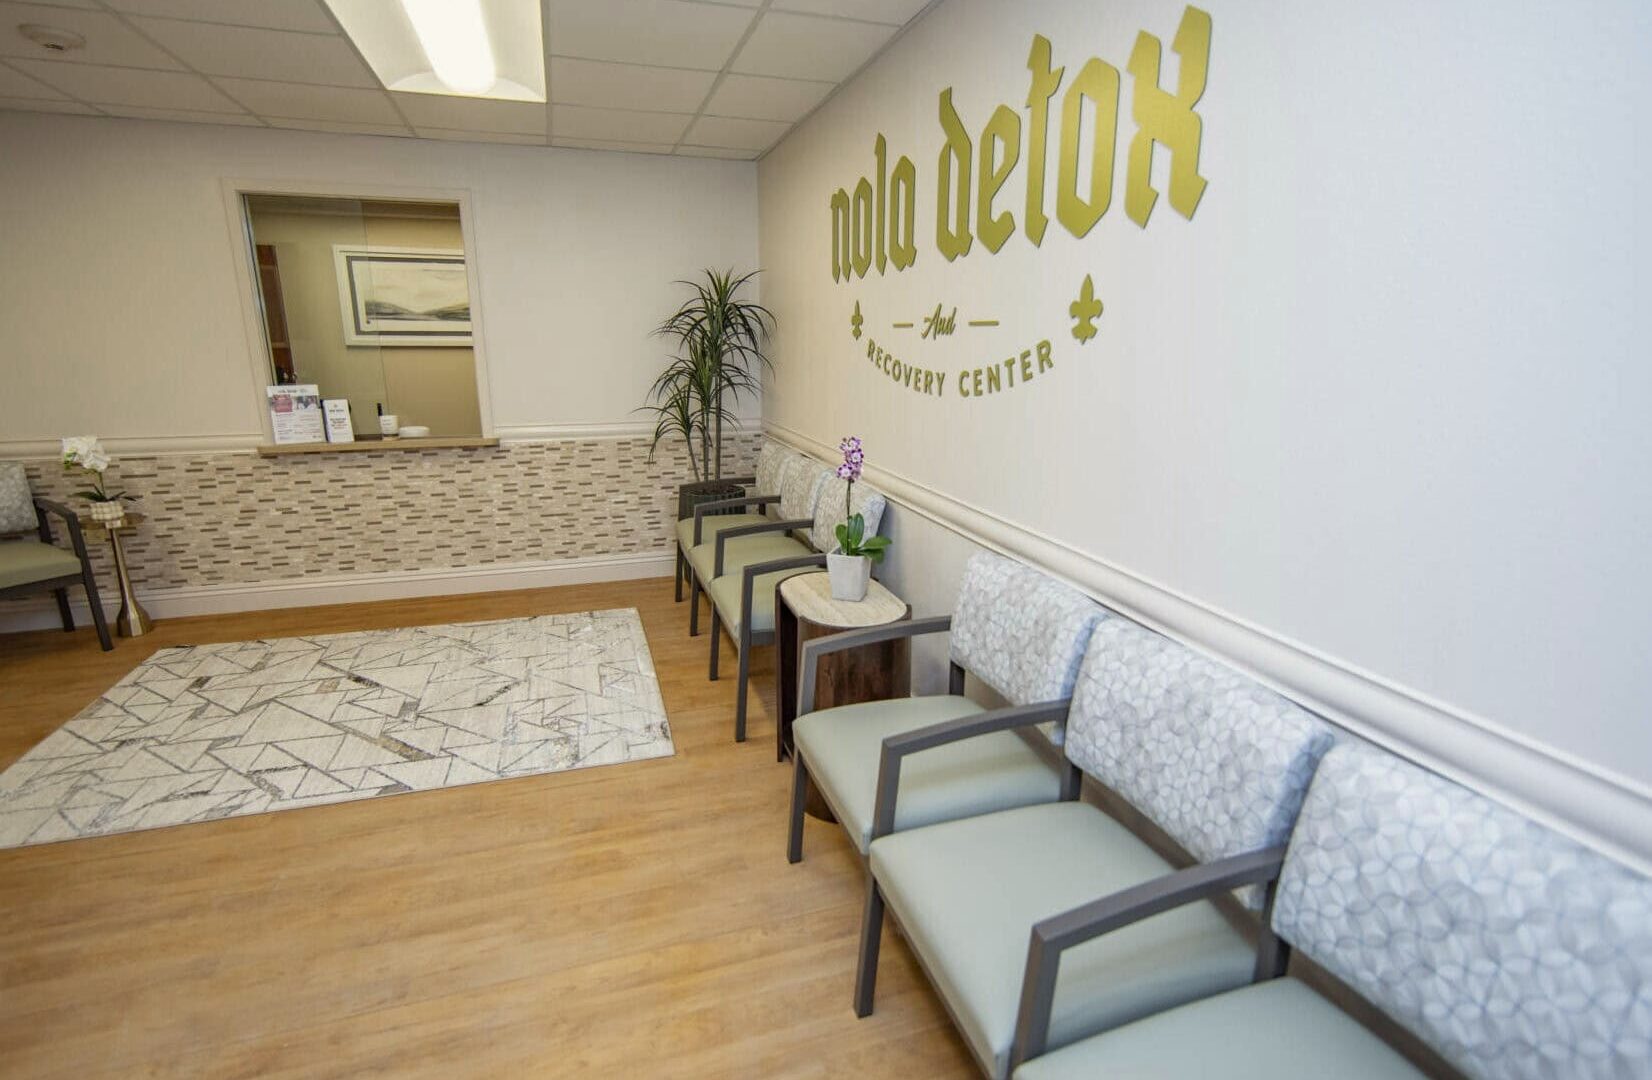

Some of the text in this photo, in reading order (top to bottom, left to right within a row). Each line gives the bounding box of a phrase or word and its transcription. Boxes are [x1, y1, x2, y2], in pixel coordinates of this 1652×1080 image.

[830, 5, 1212, 284] nola detox
[921, 303, 957, 340] And
[866, 339, 1054, 398] RECOVERY CENTER
